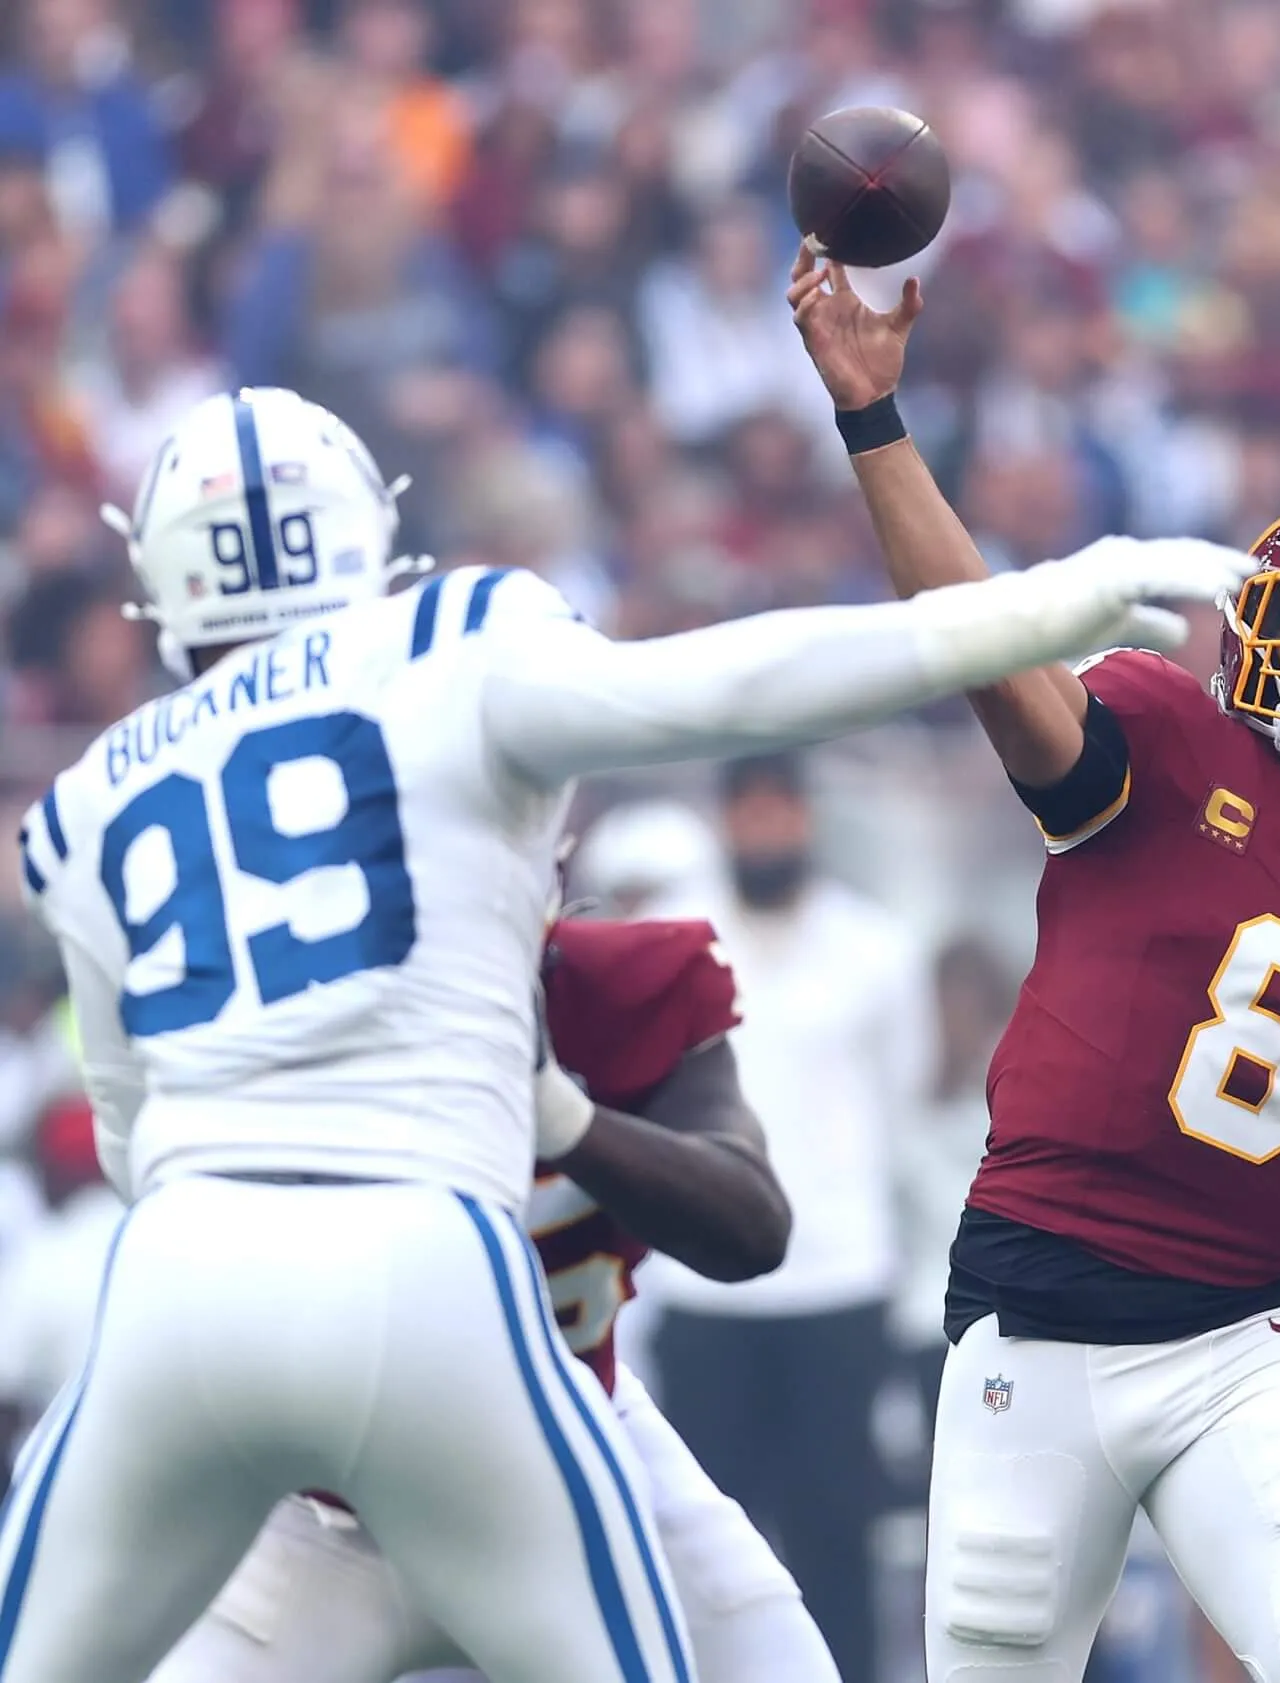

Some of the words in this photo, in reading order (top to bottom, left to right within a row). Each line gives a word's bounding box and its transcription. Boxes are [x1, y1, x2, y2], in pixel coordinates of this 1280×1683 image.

[210, 511, 318, 595] 99
[106, 631, 331, 788] BUCKNER
[1205, 788, 1255, 838] C
[100, 707, 418, 1037] 99
[986, 1390, 1006, 1406] NFL
